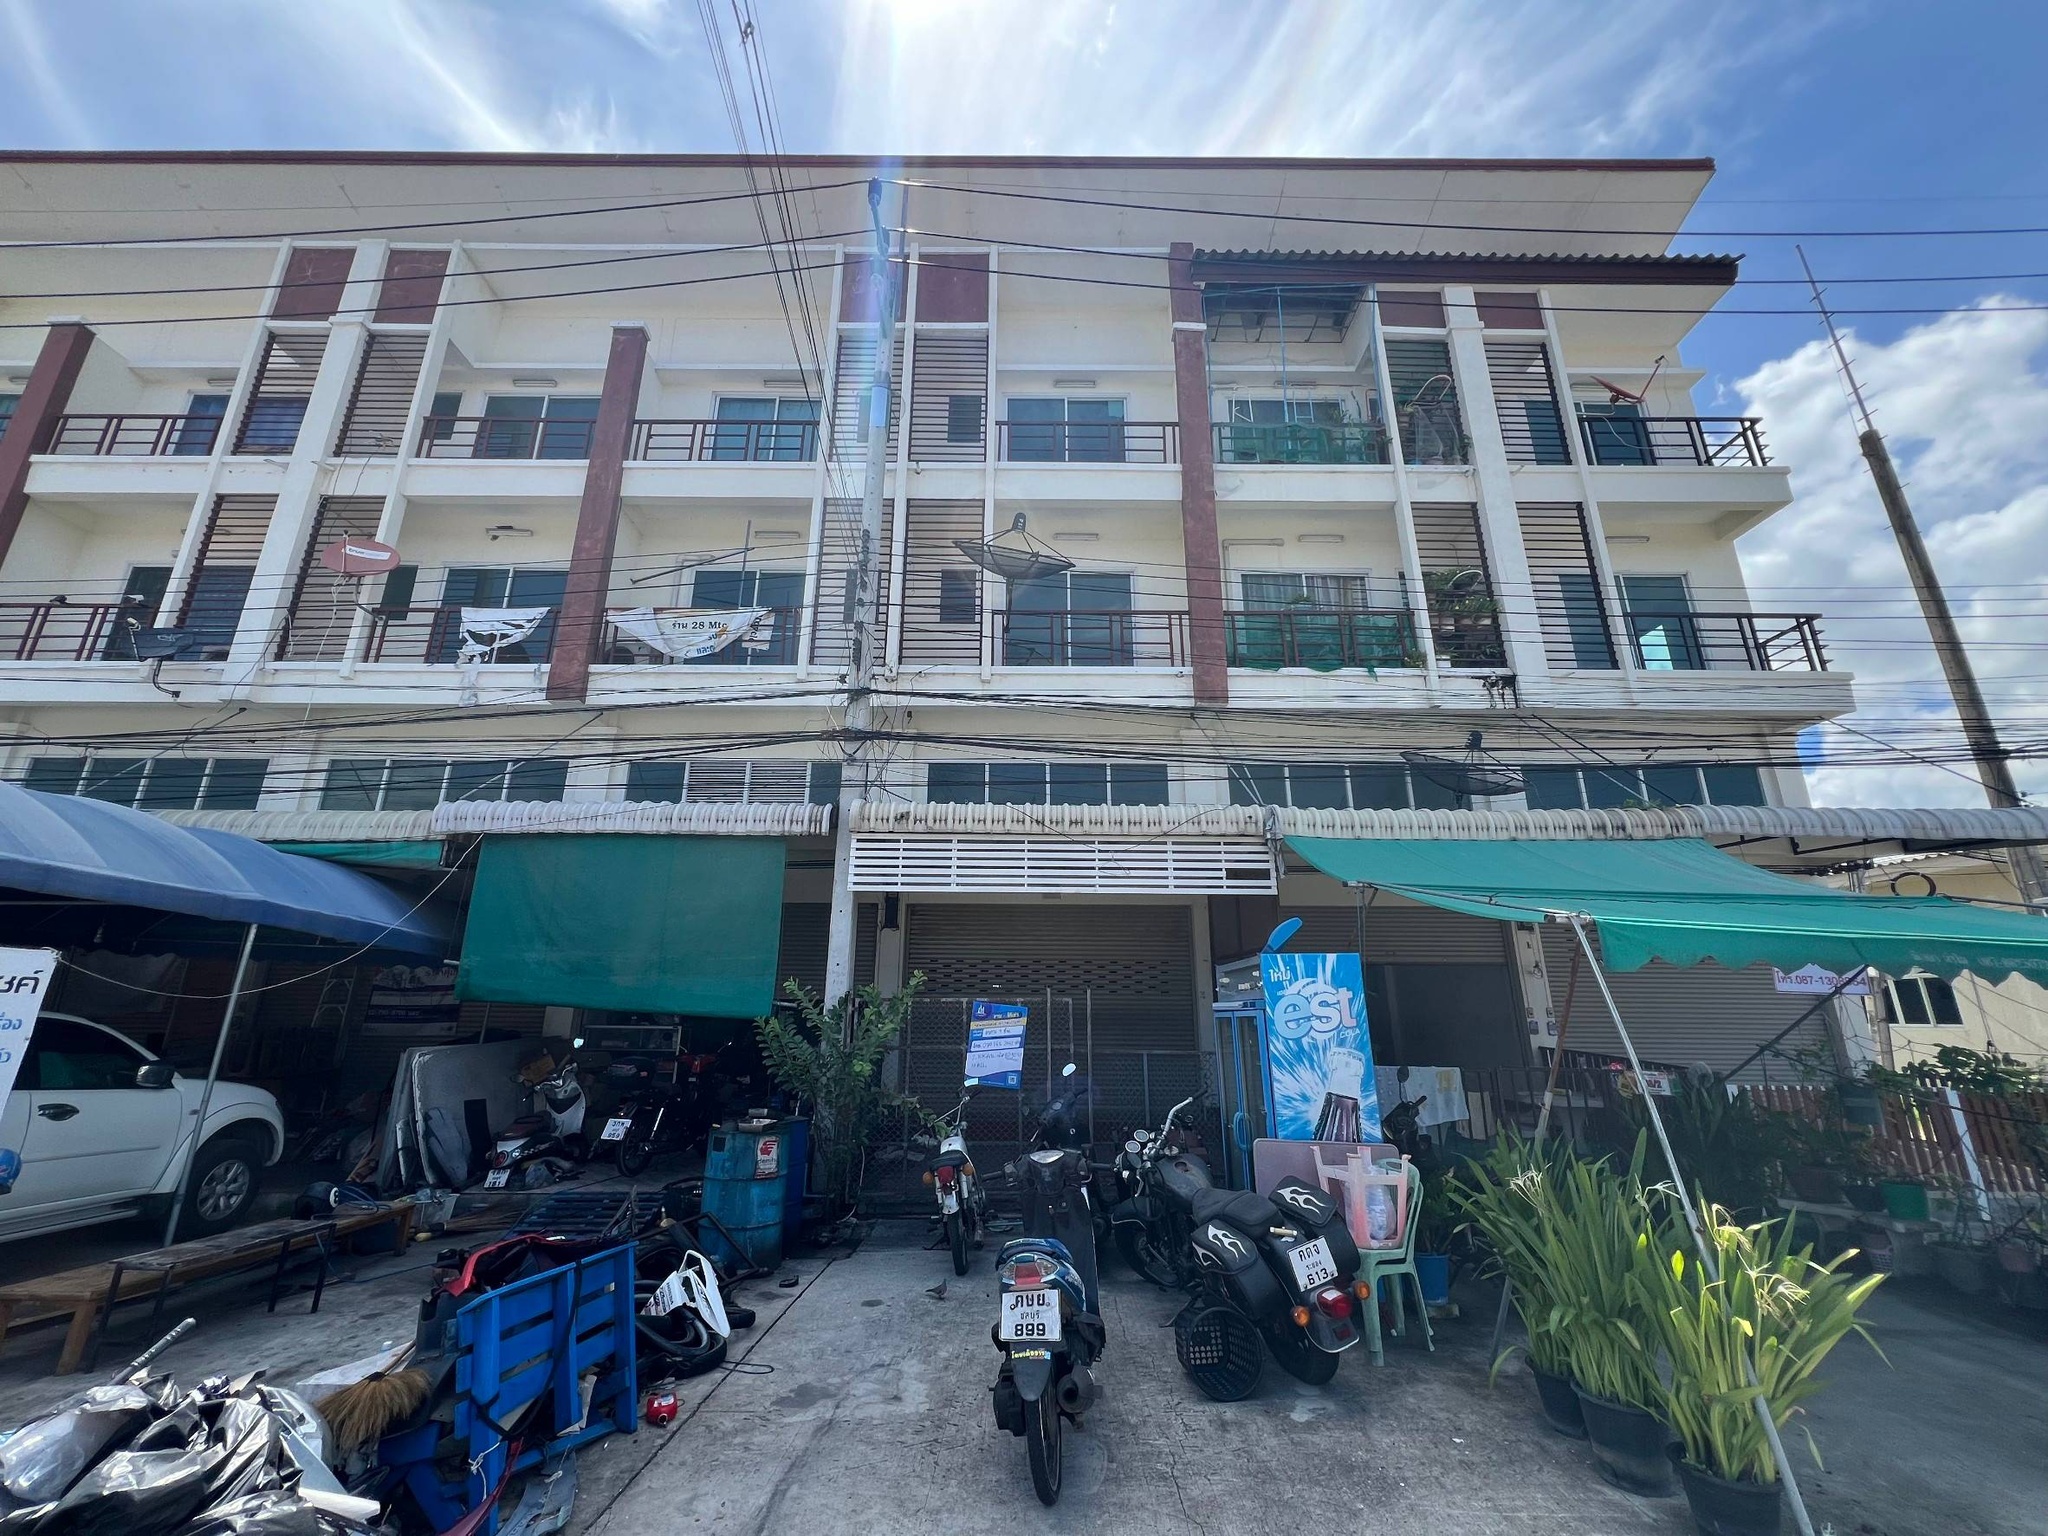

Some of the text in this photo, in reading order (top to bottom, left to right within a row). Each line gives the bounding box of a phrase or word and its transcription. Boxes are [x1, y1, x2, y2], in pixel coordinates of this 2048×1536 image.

[691, 621, 705, 629] 28
[1268, 966, 1291, 983] ใหม่
[1339, 1028, 1361, 1040] COLA
[1307, 1267, 1329, 1286] 613
[1020, 1309, 1040, 1322] ชลบุรี
[1014, 1322, 1046, 1337] 899
